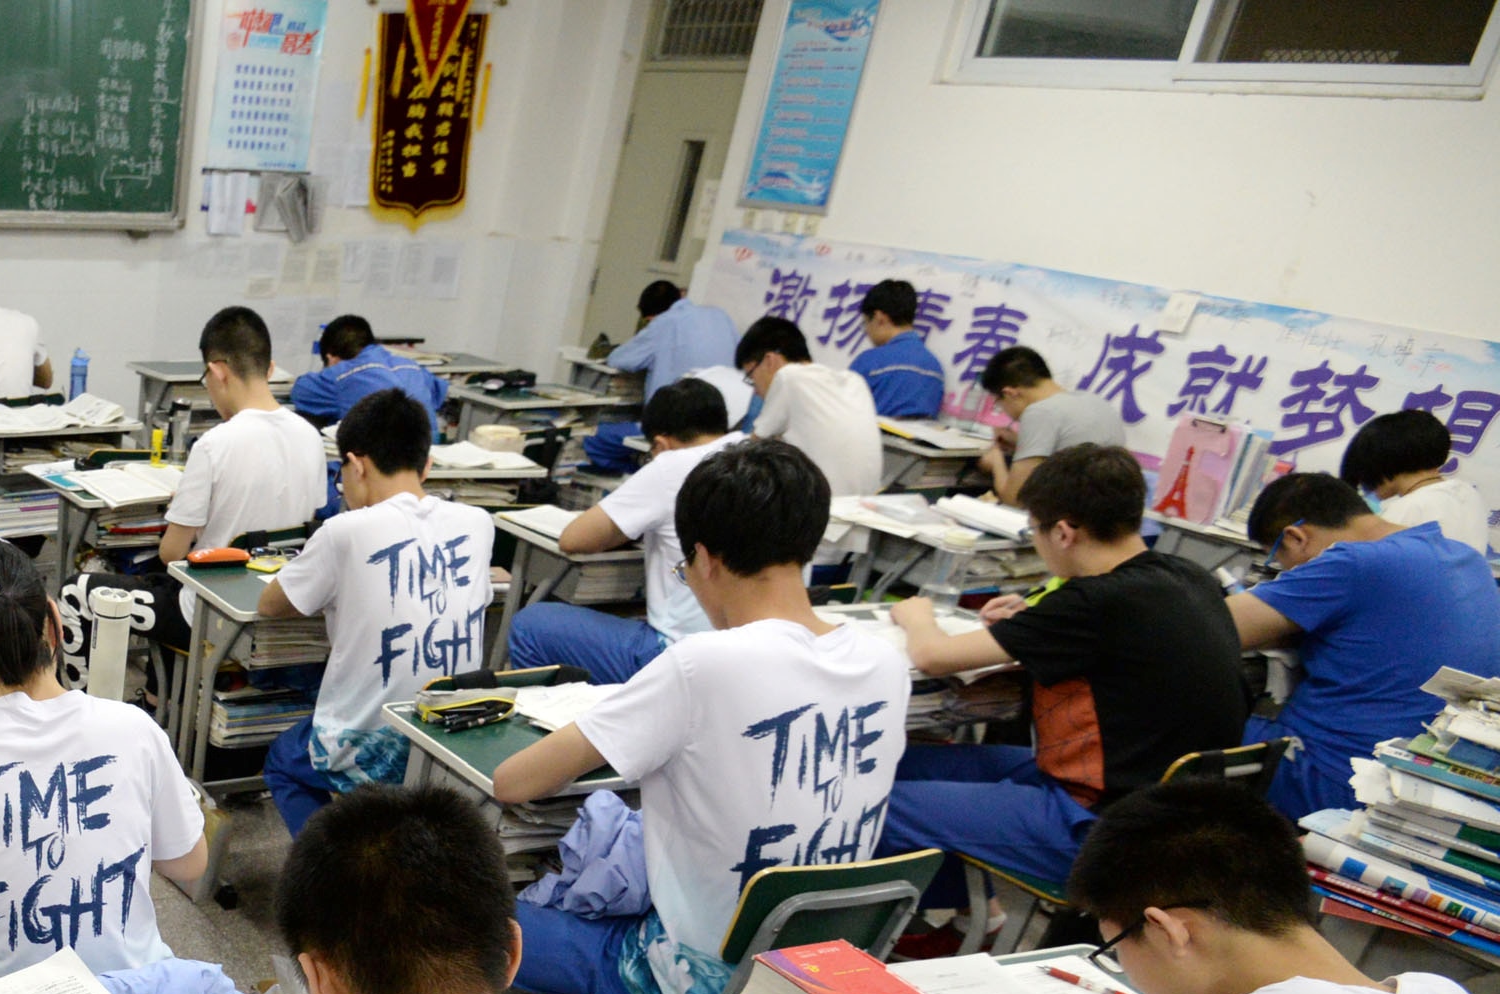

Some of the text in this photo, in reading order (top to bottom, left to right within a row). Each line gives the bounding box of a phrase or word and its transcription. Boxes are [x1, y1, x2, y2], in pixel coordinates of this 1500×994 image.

[1076, 322, 1500, 474] 成就梦想
[367, 534, 472, 604] TIME
[420, 588, 447, 615] TO
[374, 606, 486, 688] FIGHT
[742, 701, 890, 808] TIME
[815, 779, 845, 815] TO
[30, 831, 66, 873] TO
